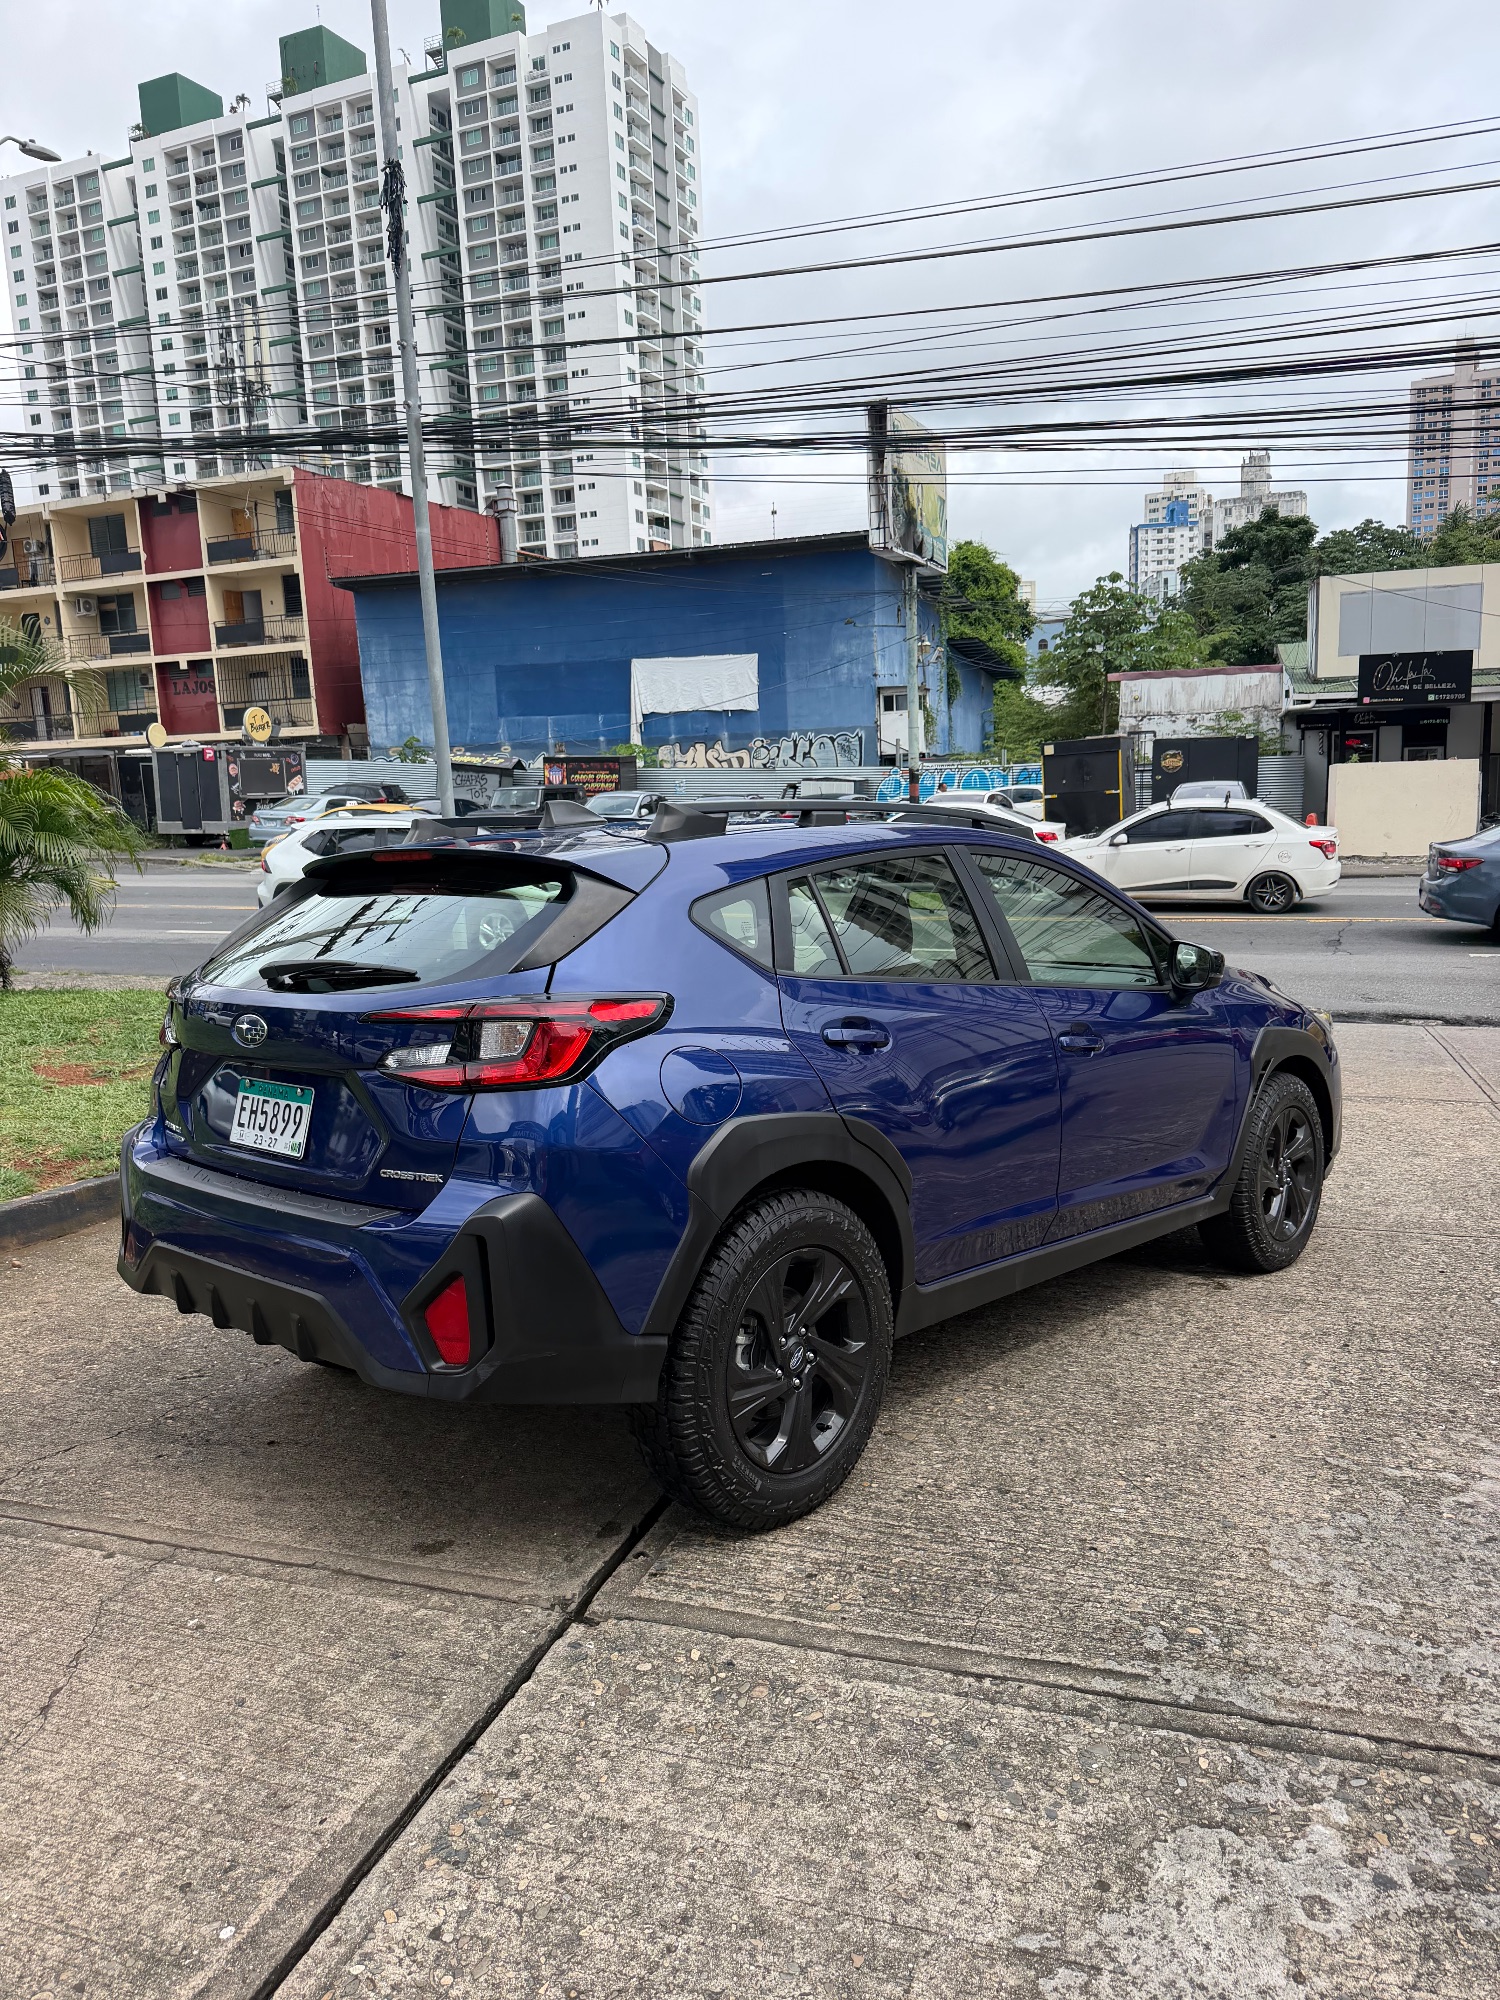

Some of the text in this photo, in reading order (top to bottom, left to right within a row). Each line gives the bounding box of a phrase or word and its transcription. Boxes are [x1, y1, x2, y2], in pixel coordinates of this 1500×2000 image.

[452, 774, 488, 787] CHAPAS
[466, 787, 488, 800] TOP
[259, 1084, 289, 1099] PANAMA
[237, 1094, 304, 1139] EH5899
[380, 1169, 444, 1183] CROSSTREK
